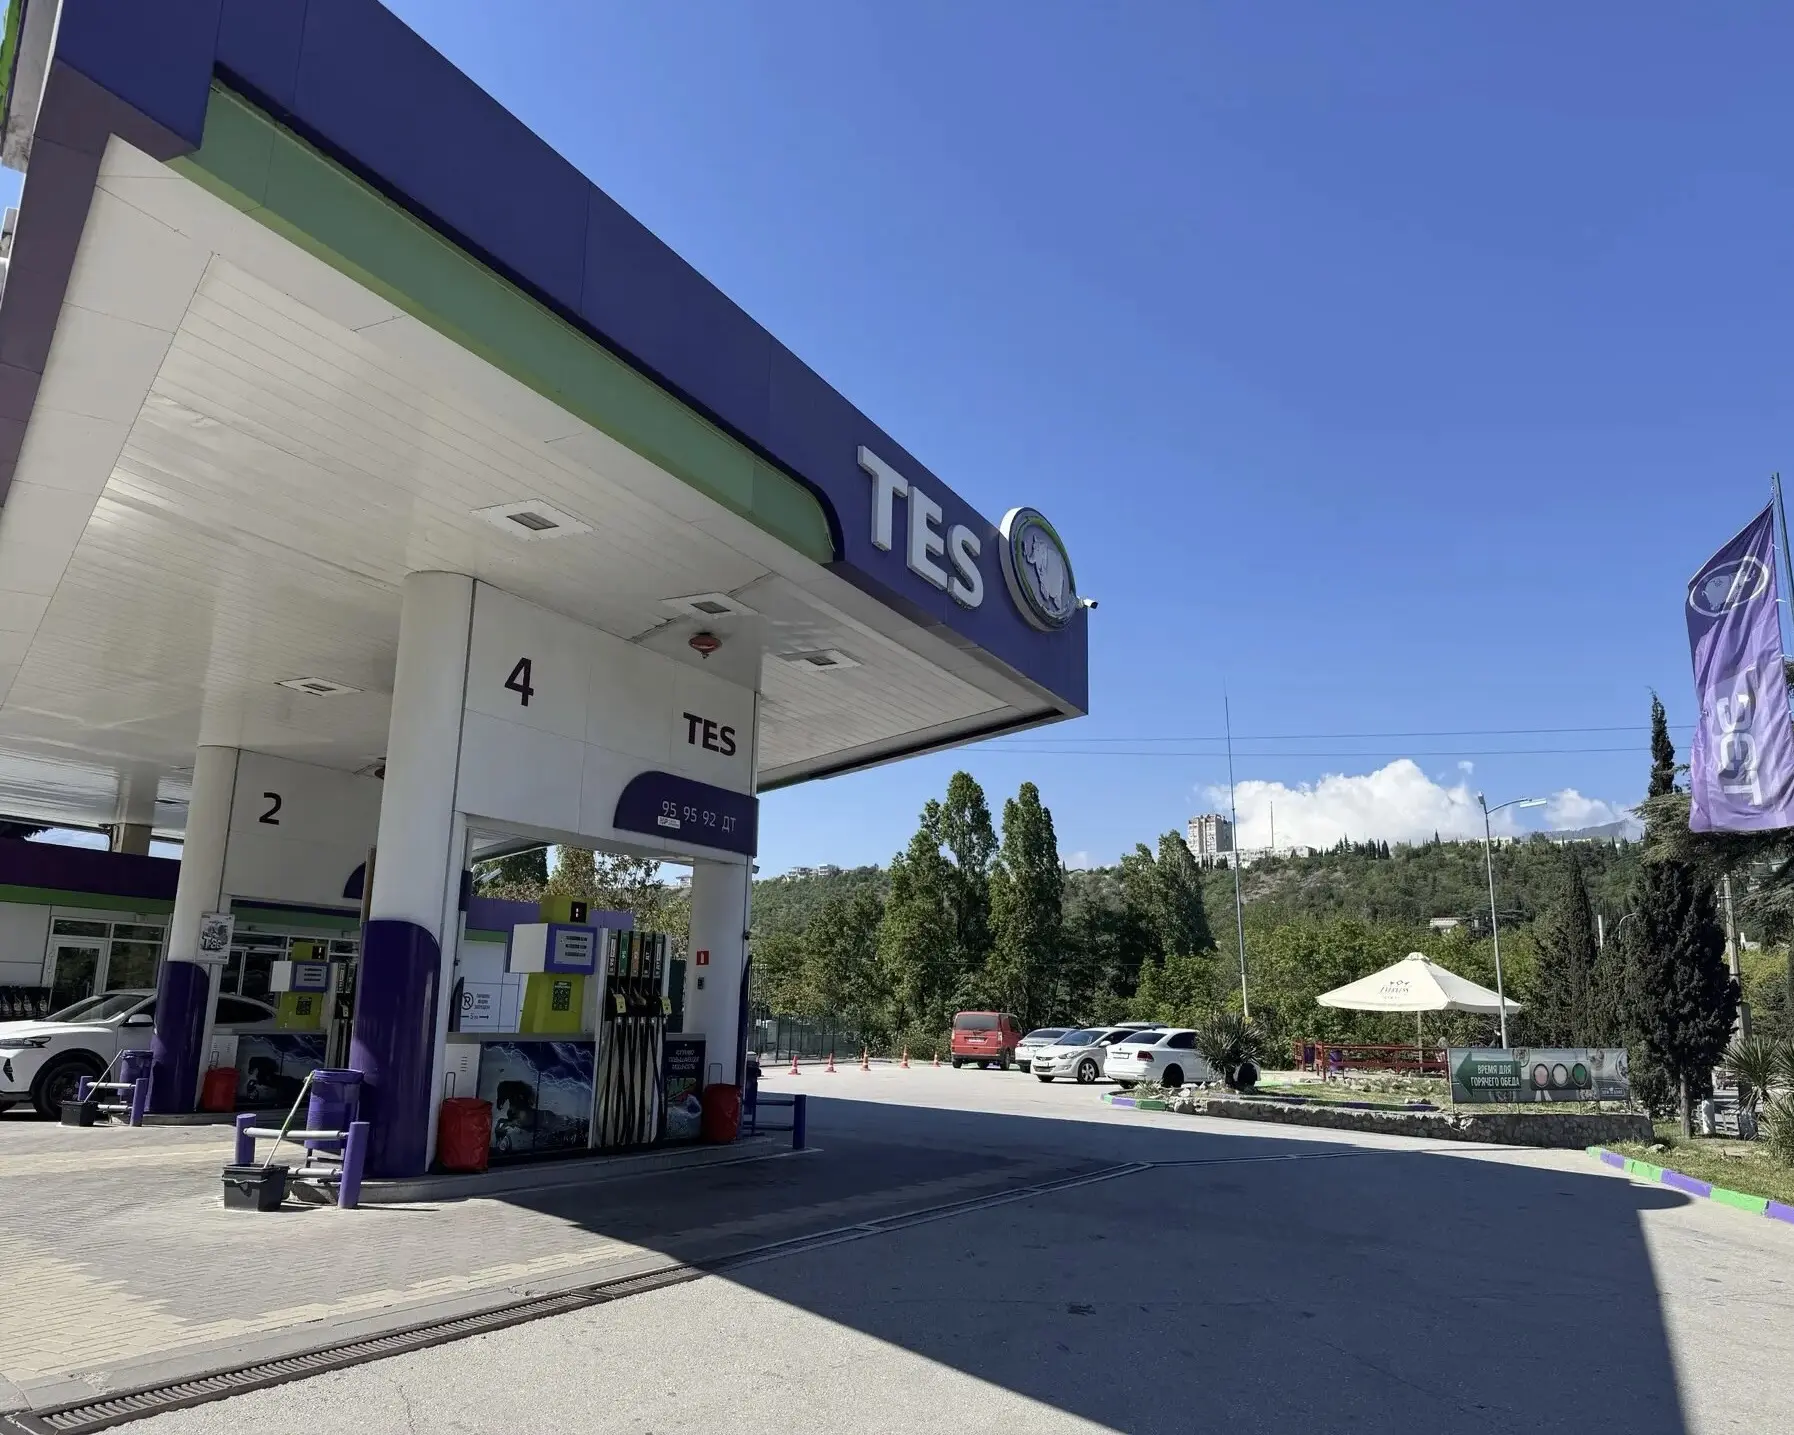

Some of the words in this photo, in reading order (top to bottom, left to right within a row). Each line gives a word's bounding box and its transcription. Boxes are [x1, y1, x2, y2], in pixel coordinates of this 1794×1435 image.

[857, 445, 984, 610] TES
[504, 657, 535, 707] 4
[683, 712, 736, 757] TES
[258, 792, 282, 825] 2
[661, 800, 677, 818] 95
[683, 806, 697, 823] 95
[702, 810, 716, 827] 92
[721, 815, 737, 833] ДТ
[1470, 1076, 1499, 1087] ГОРЯЧЕГО
[1500, 1076, 1521, 1087] ОБЕДА
[1477, 1064, 1498, 1075] ВРЕМЯ
[1499, 1065, 1512, 1075] ДЛЯ
